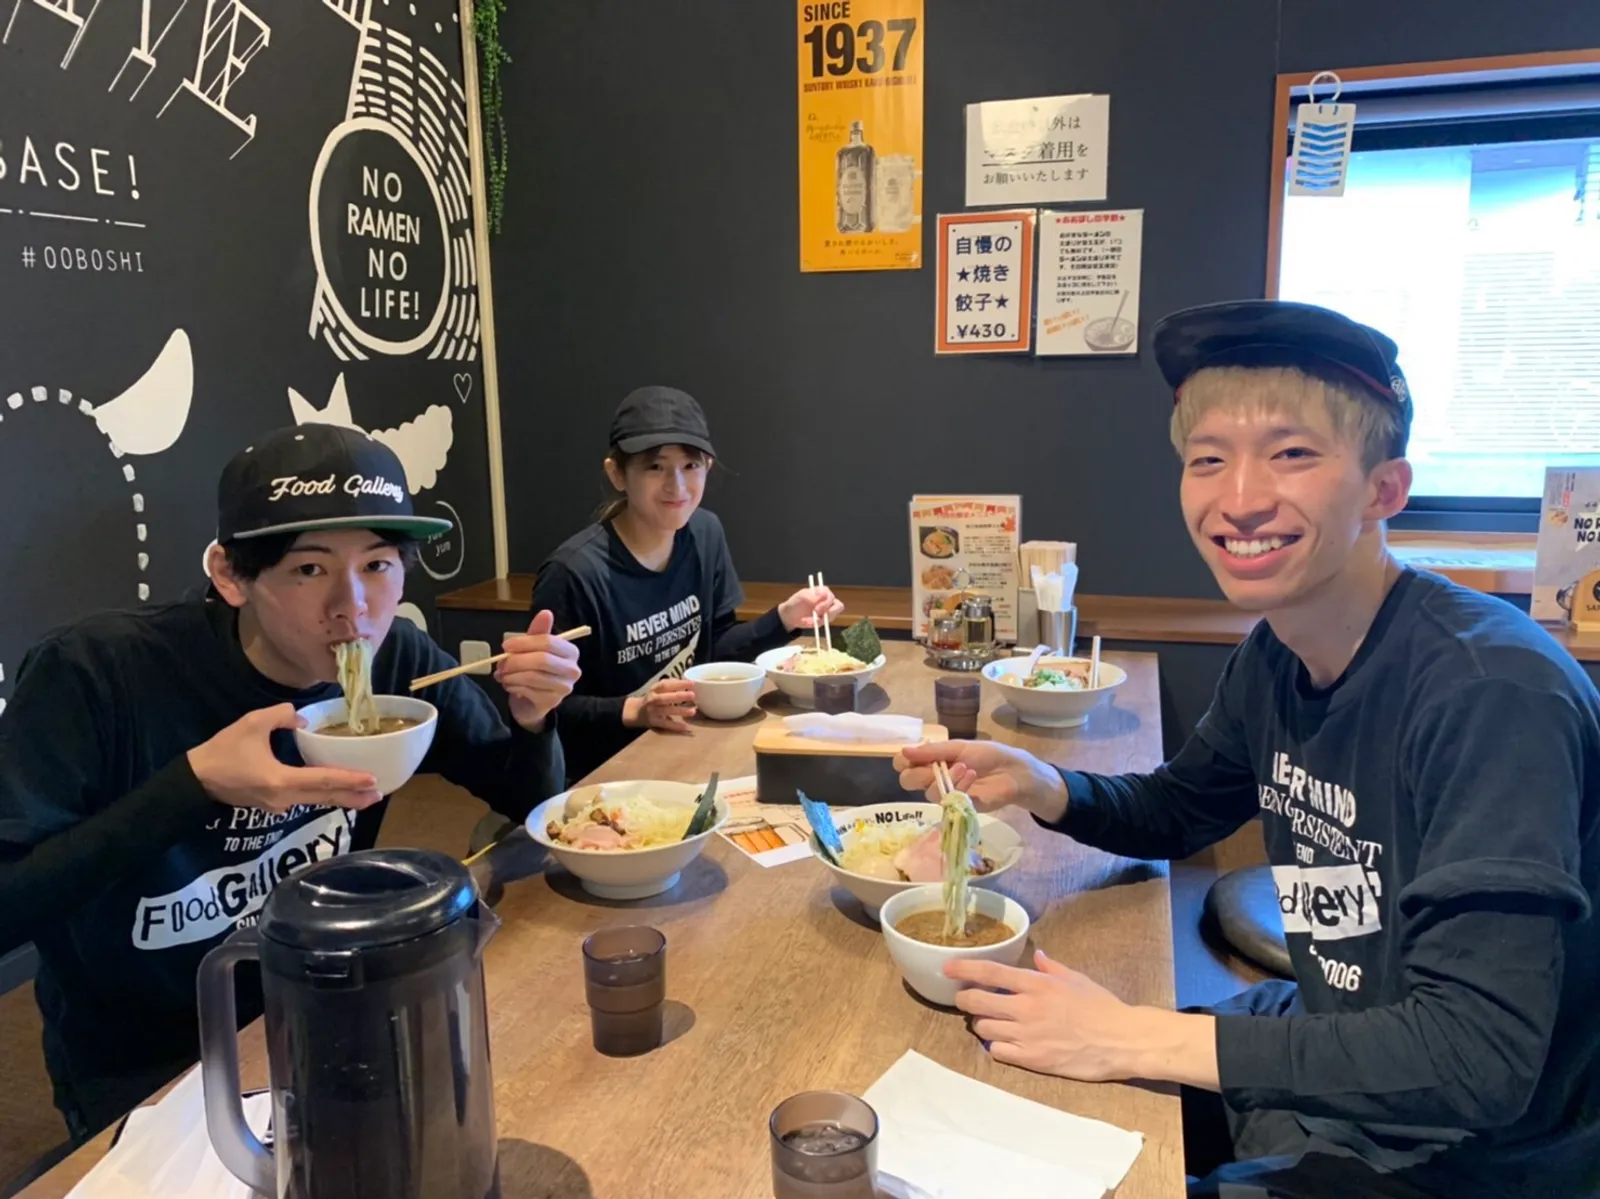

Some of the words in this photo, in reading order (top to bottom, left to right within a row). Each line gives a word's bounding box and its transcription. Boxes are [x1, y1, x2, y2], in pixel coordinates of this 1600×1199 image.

[804, 1, 850, 22] SINCE
[804, 17, 917, 78] 1937
[363, 165, 402, 202] NO
[983, 168, 1088, 184] お願いいたします
[348, 203, 420, 244] RAMEN
[956, 236, 1012, 255] 自慢の
[369, 247, 407, 281] NO
[973, 264, 1010, 282] 焼き
[361, 287, 419, 320] LIFE!
[955, 293, 992, 312] 餃子
[957, 323, 1006, 339] ¥430
[268, 474, 336, 501] Food
[343, 474, 404, 504] Gallery
[1574, 518, 1593, 529] NO
[1577, 531, 1596, 542] NO
[626, 611, 670, 643] NEVER
[669, 594, 700, 625] MIND
[617, 640, 653, 664] BEING
[1307, 775, 1356, 828] MIND
[875, 812, 893, 824] NO
[224, 837, 240, 852] TO
[241, 834, 265, 850] THE
